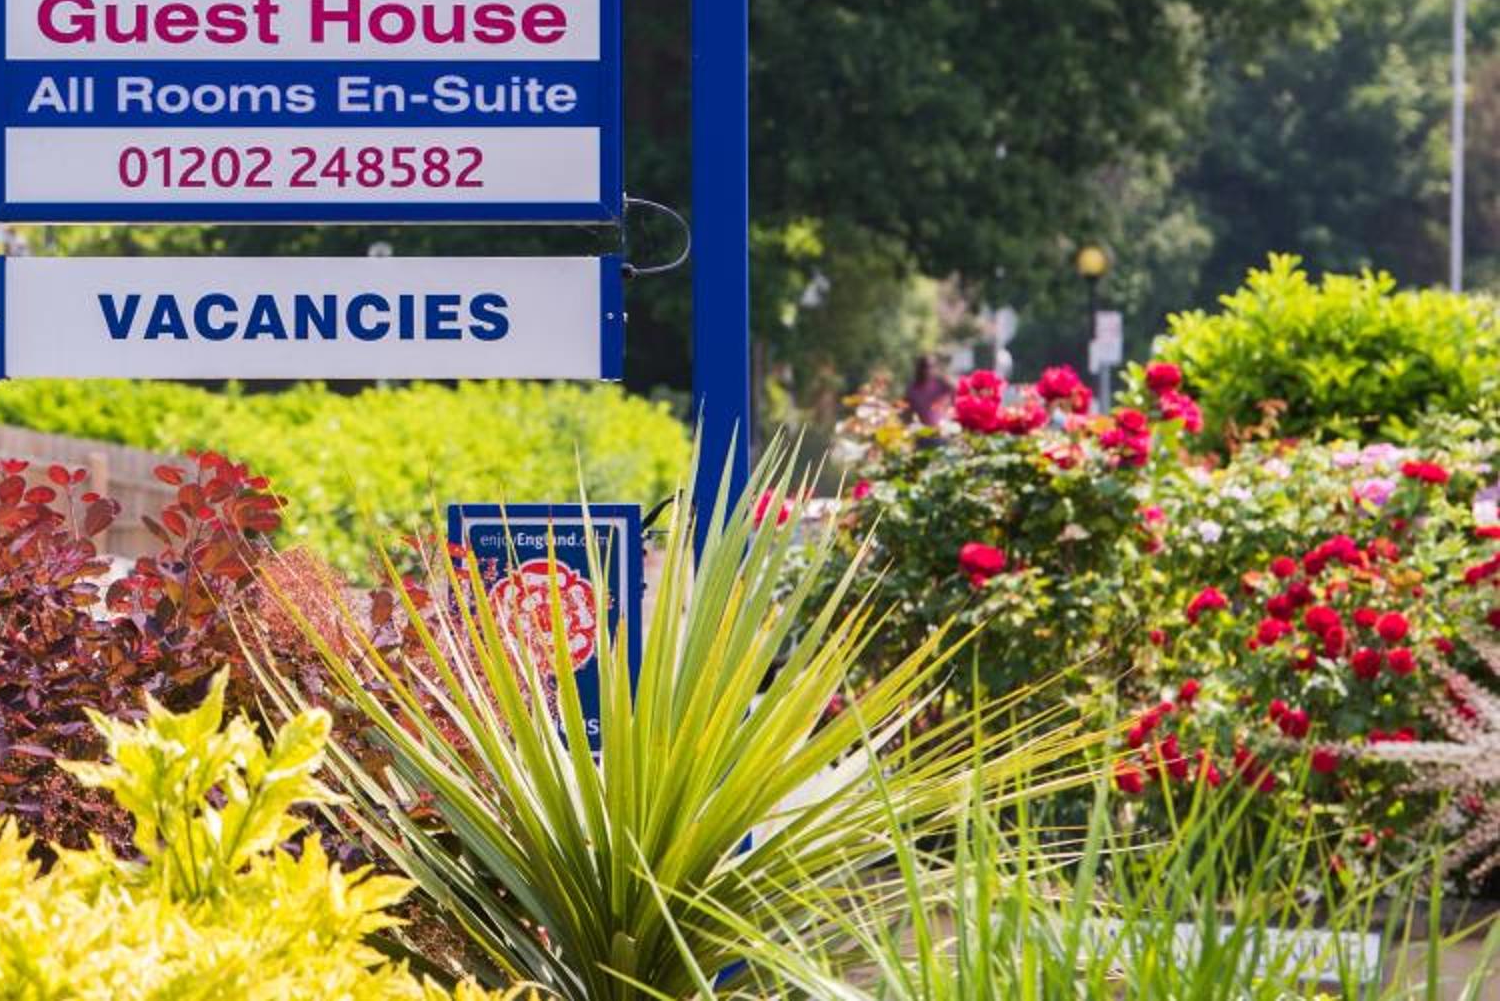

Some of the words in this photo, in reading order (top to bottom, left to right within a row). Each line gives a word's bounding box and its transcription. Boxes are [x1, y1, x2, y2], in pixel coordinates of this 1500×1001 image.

[27, 76, 95, 112] All
[116, 76, 316, 113] Rooms
[337, 75, 578, 113] En-Suite
[118, 146, 274, 188] 01202
[288, 146, 486, 189] 248582
[97, 293, 510, 342] VACANCIES
[479, 532, 610, 550] enjoEnglnd.cm
